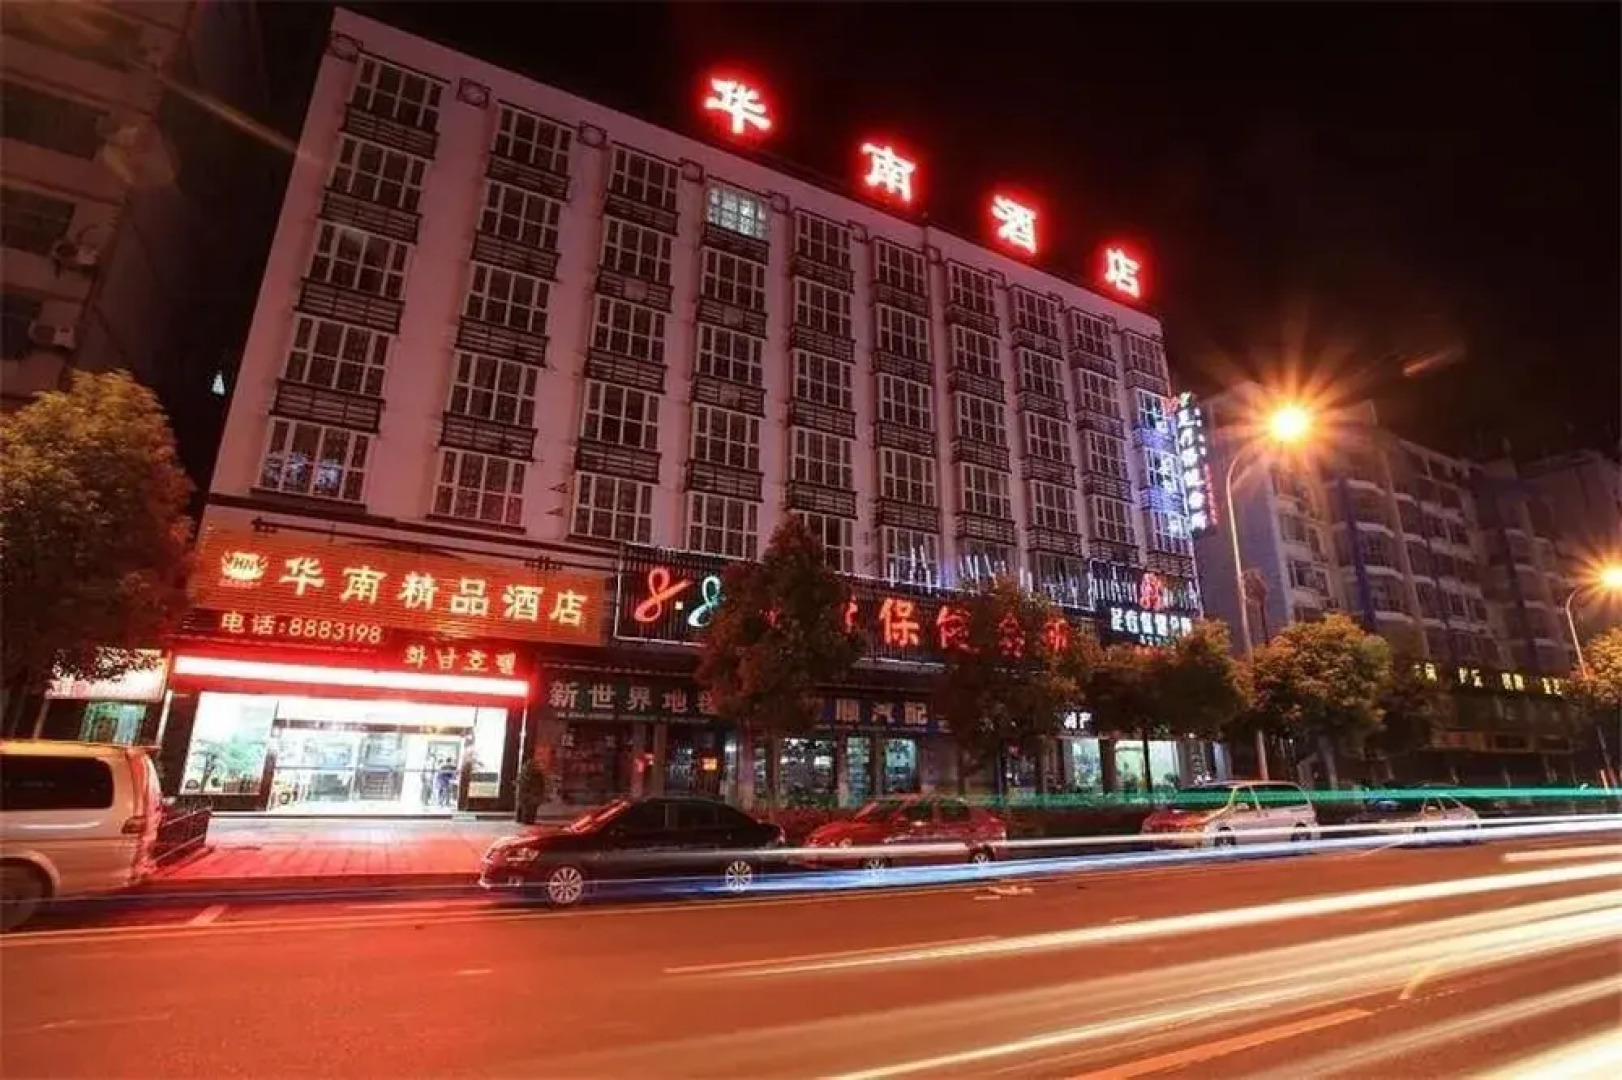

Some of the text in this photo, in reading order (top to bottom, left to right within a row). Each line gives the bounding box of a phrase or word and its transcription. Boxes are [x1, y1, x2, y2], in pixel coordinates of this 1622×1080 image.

[704, 77, 1140, 298] 华南酒店
[279, 556, 588, 626] 华南精品酒店
[221, 611, 382, 644] 电话:8883198
